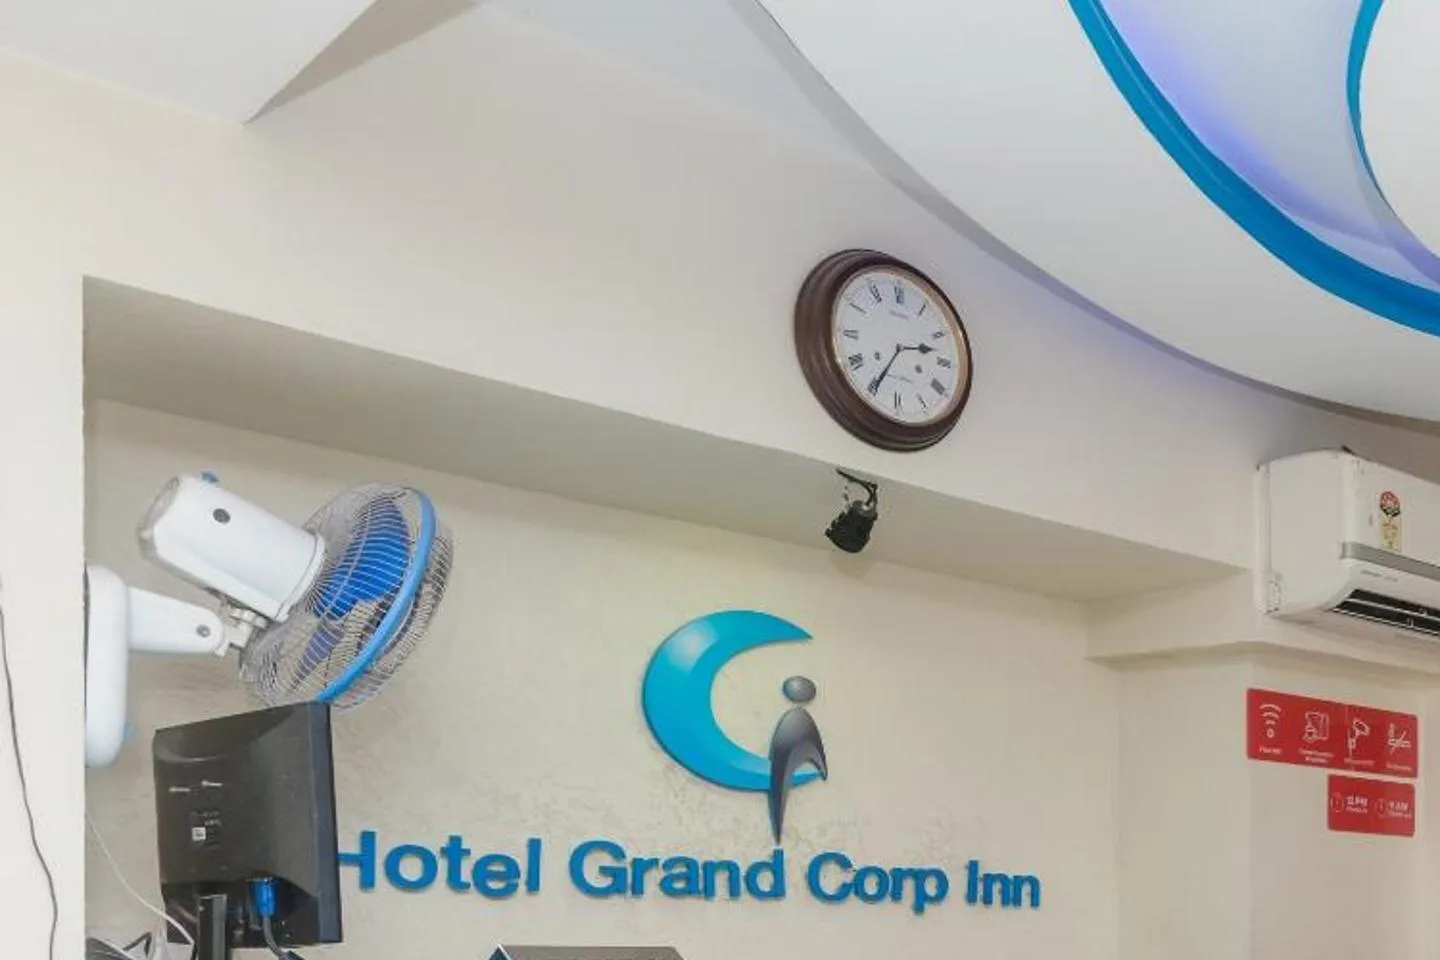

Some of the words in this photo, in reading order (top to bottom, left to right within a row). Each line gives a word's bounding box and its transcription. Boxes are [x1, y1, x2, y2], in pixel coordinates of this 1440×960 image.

[336, 830, 542, 900] Hotel
[568, 839, 787, 900] Grand
[804, 851, 950, 916] Corp
[963, 858, 1041, 908] Inn
